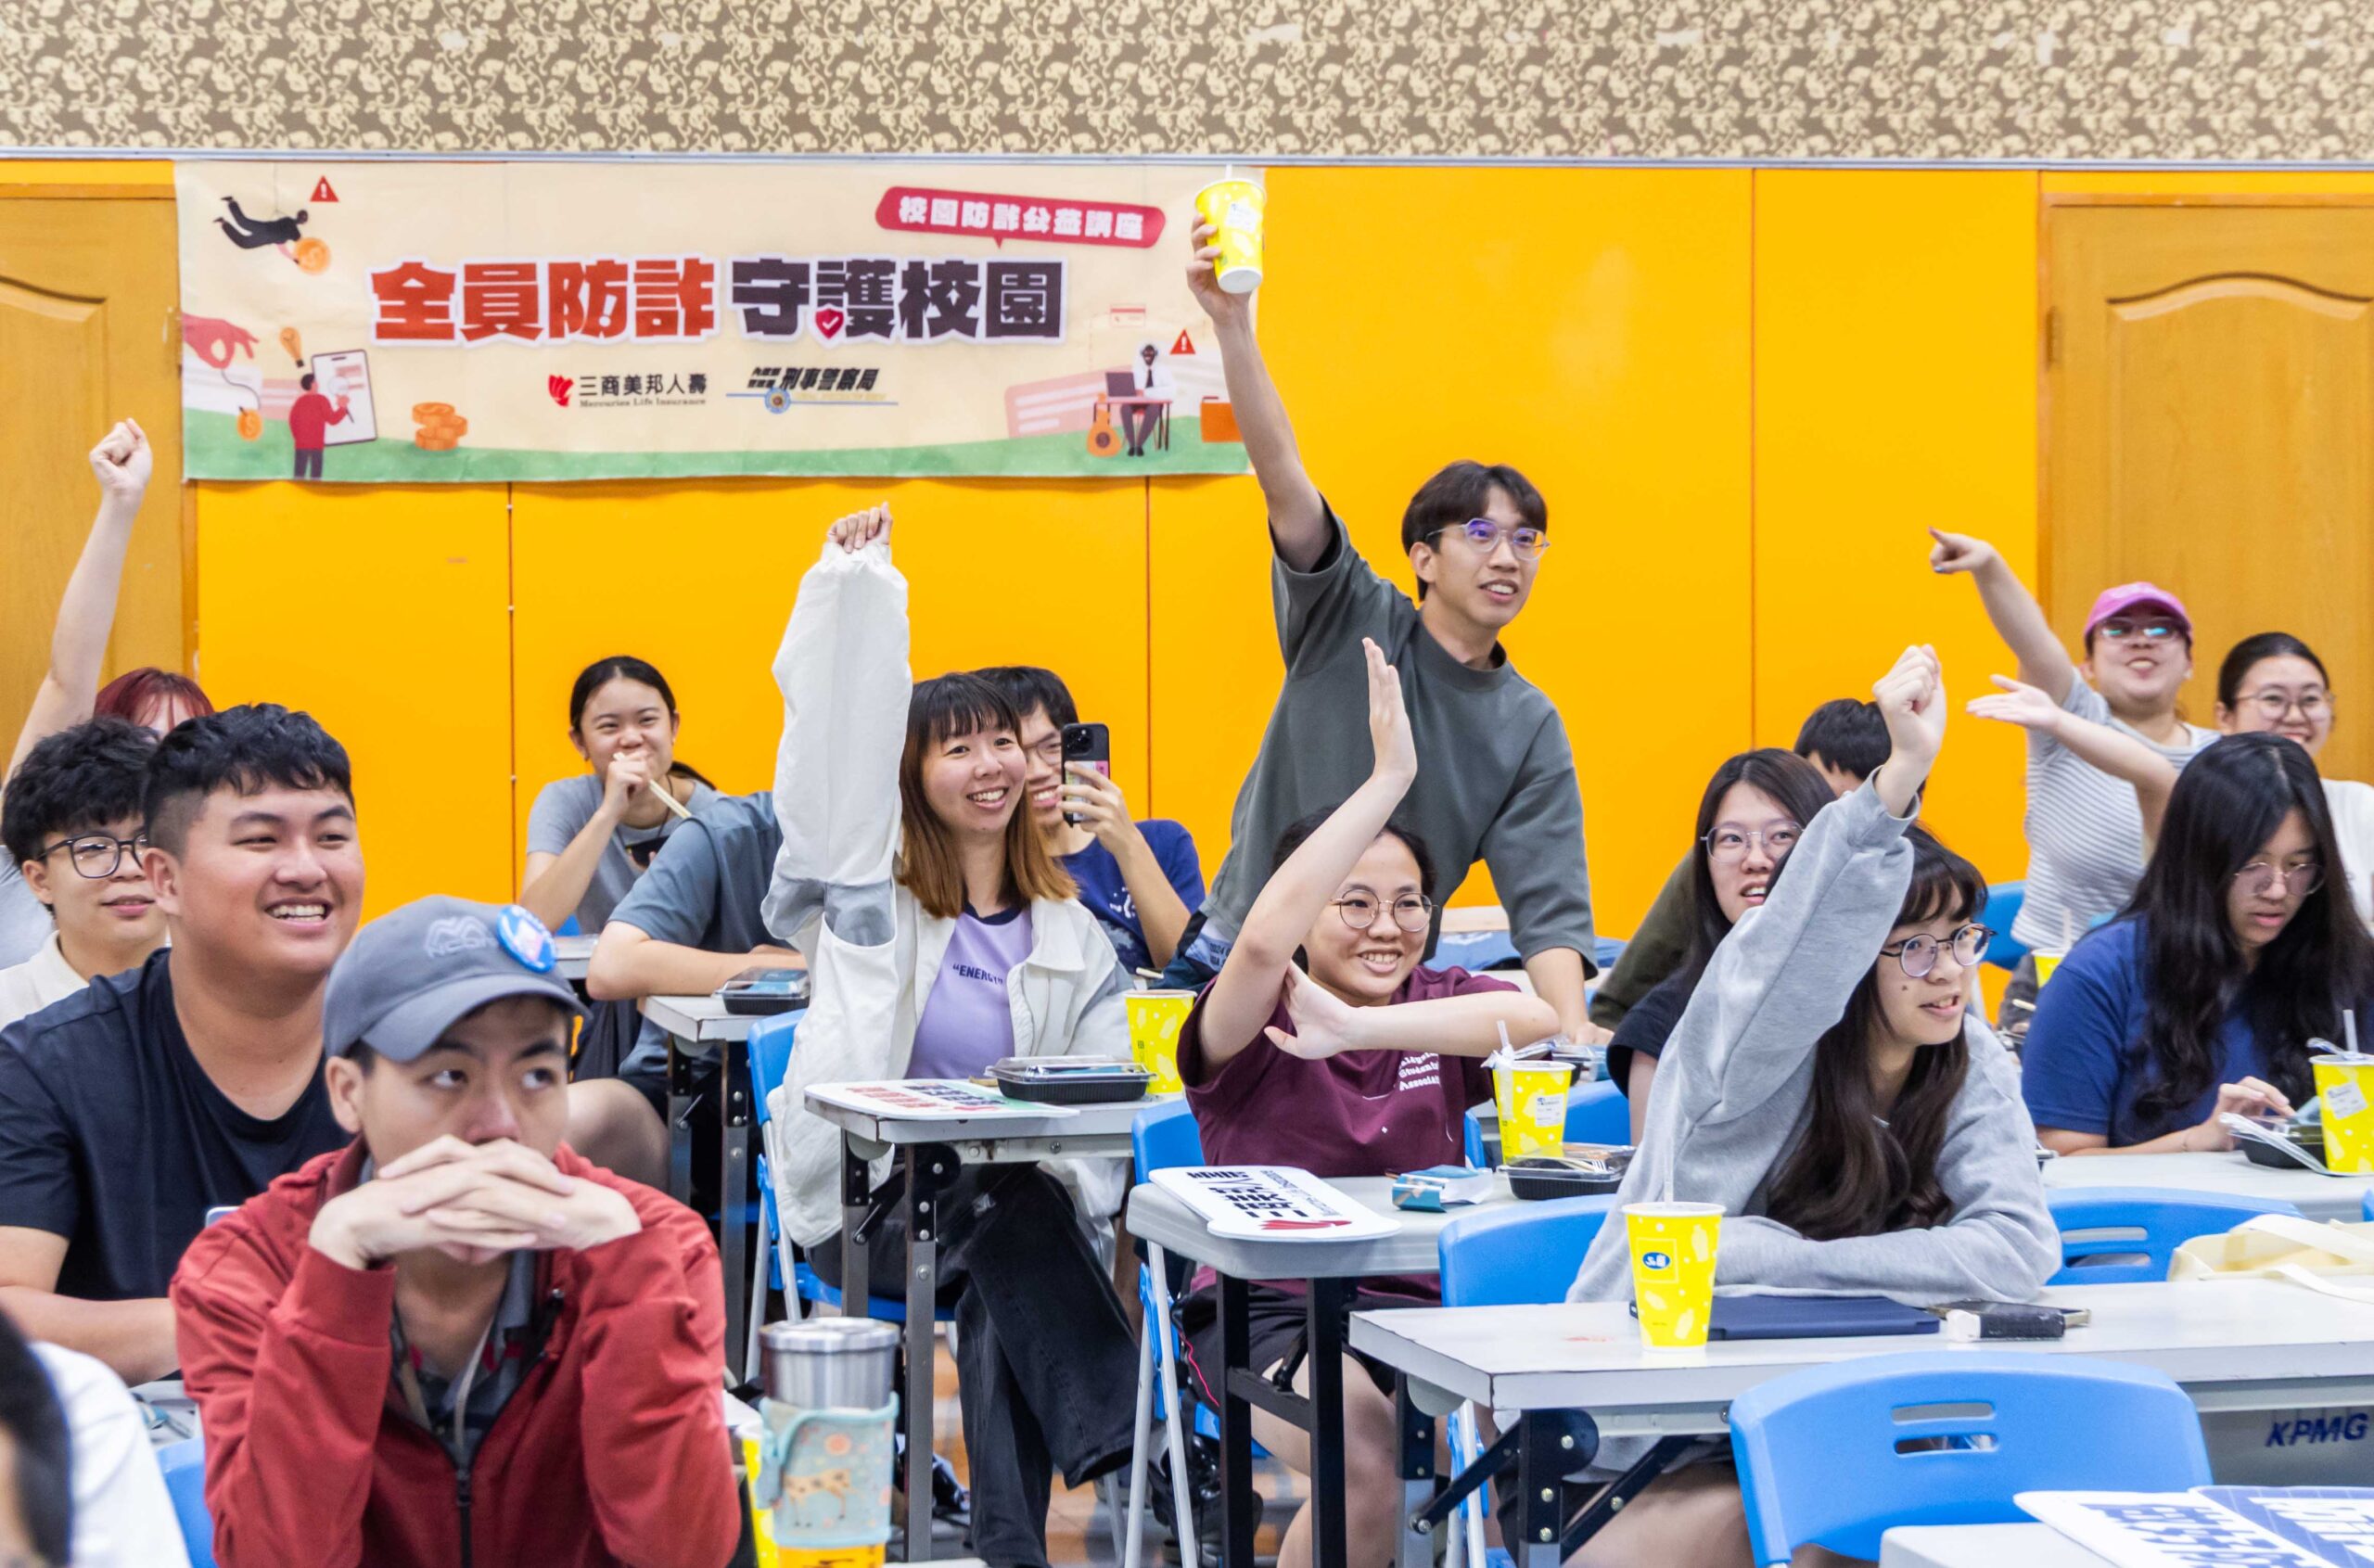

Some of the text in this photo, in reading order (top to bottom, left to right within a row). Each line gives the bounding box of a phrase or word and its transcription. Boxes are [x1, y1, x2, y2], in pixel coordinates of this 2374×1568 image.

[371, 257, 1064, 340] 全員防詐 守護校園
[579, 373, 707, 396] 三商美邦人壽
[2265, 1412, 2368, 1447] KPMG
